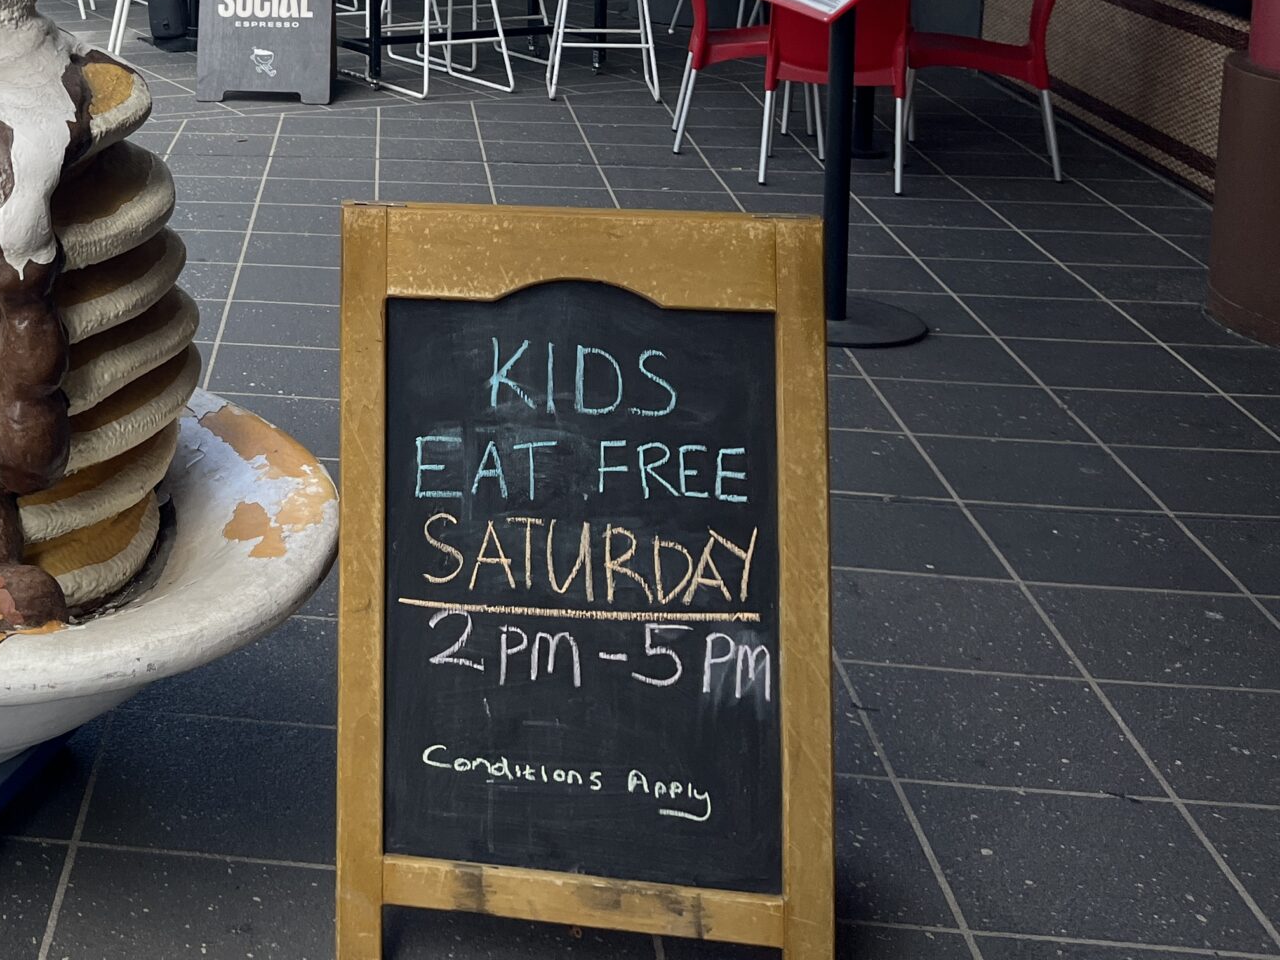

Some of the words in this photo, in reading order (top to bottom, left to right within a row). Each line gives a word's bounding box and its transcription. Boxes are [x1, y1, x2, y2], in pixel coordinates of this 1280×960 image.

[489, 336, 678, 418] KIDS
[414, 436, 558, 500] EAT
[597, 440, 749, 503] FREE
[422, 512, 759, 606] SATURDAY
[427, 608, 485, 673] 2
[626, 770, 712, 821] Apply
